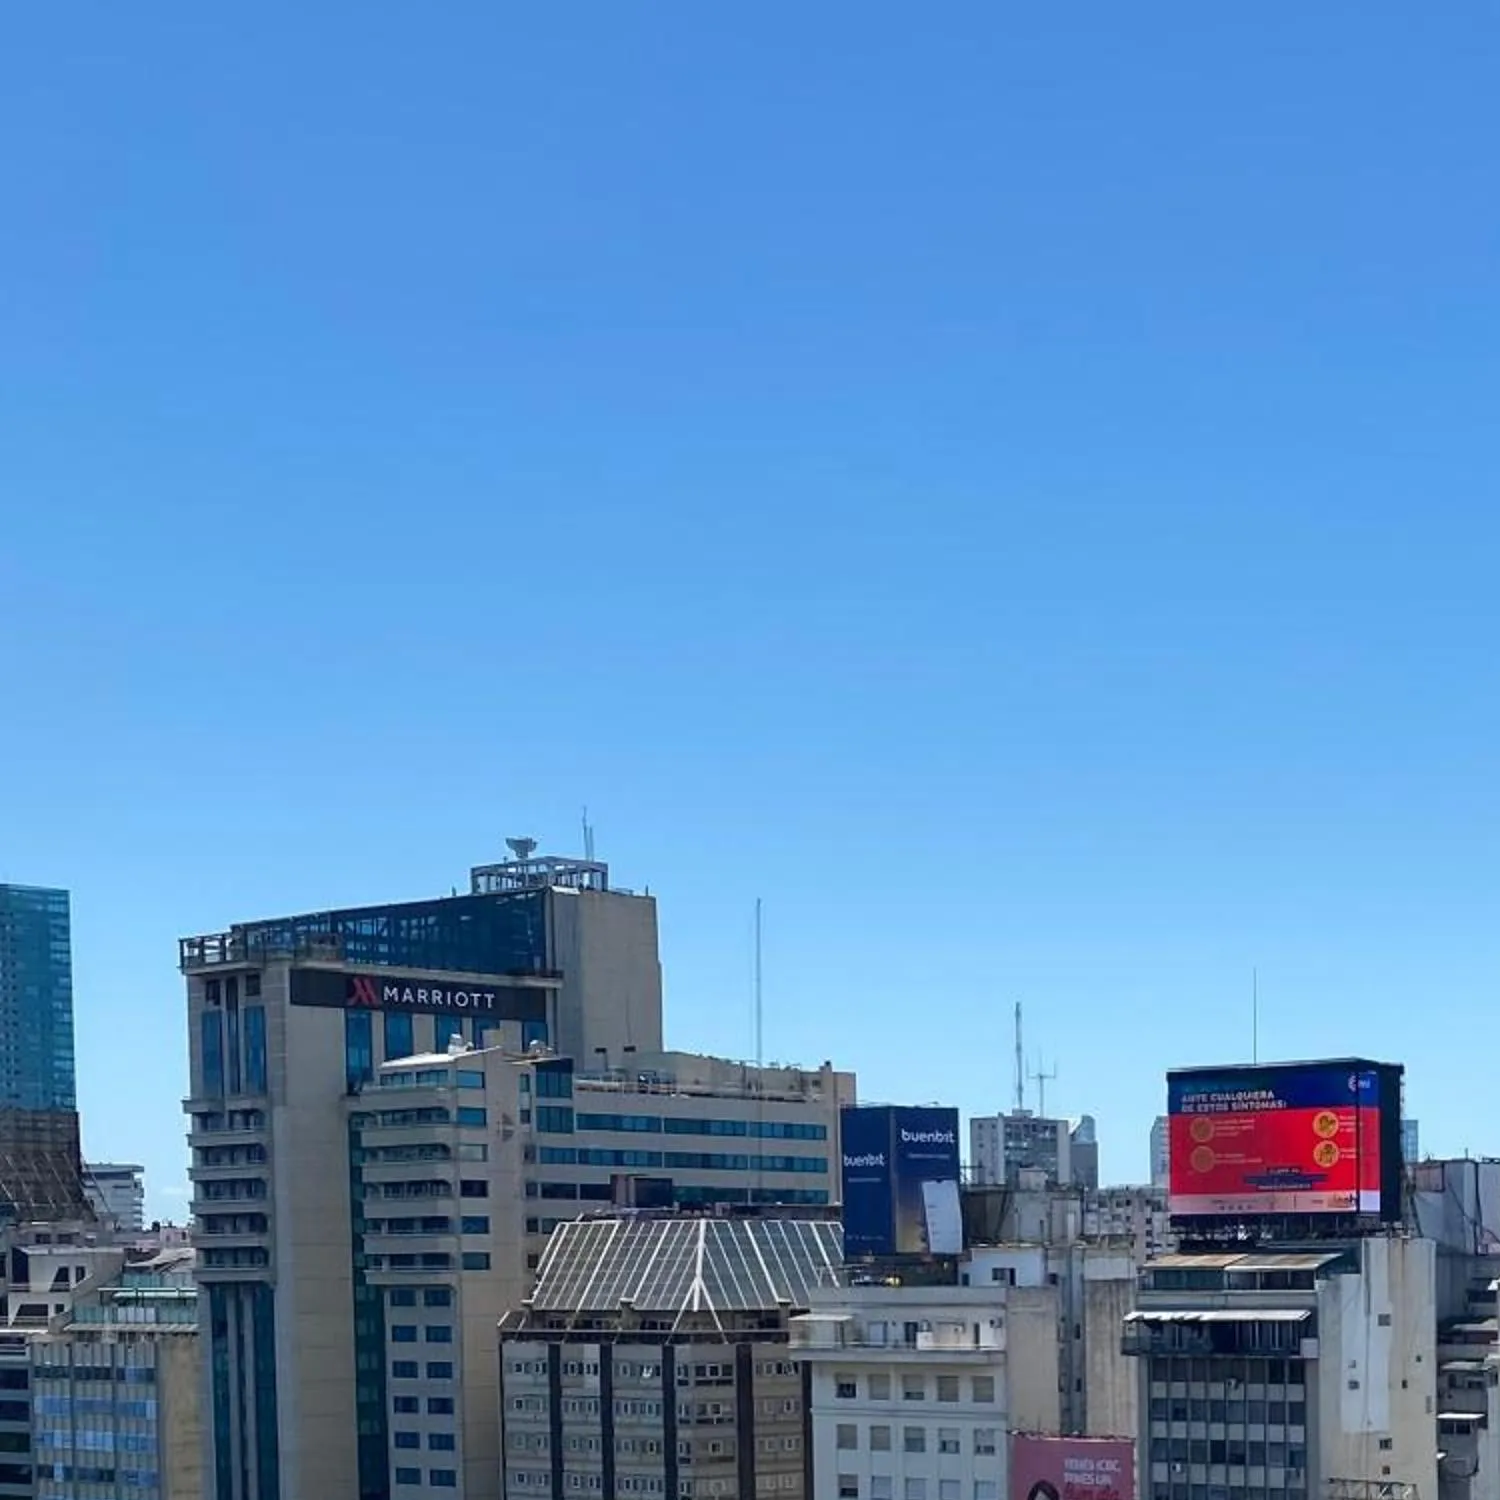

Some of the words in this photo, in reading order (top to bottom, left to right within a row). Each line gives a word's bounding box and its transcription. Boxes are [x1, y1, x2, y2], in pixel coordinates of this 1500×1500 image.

[383, 986, 495, 1009] MARRIOTT
[901, 1128, 955, 1143] buenbit
[843, 1153, 885, 1167] buenbit
